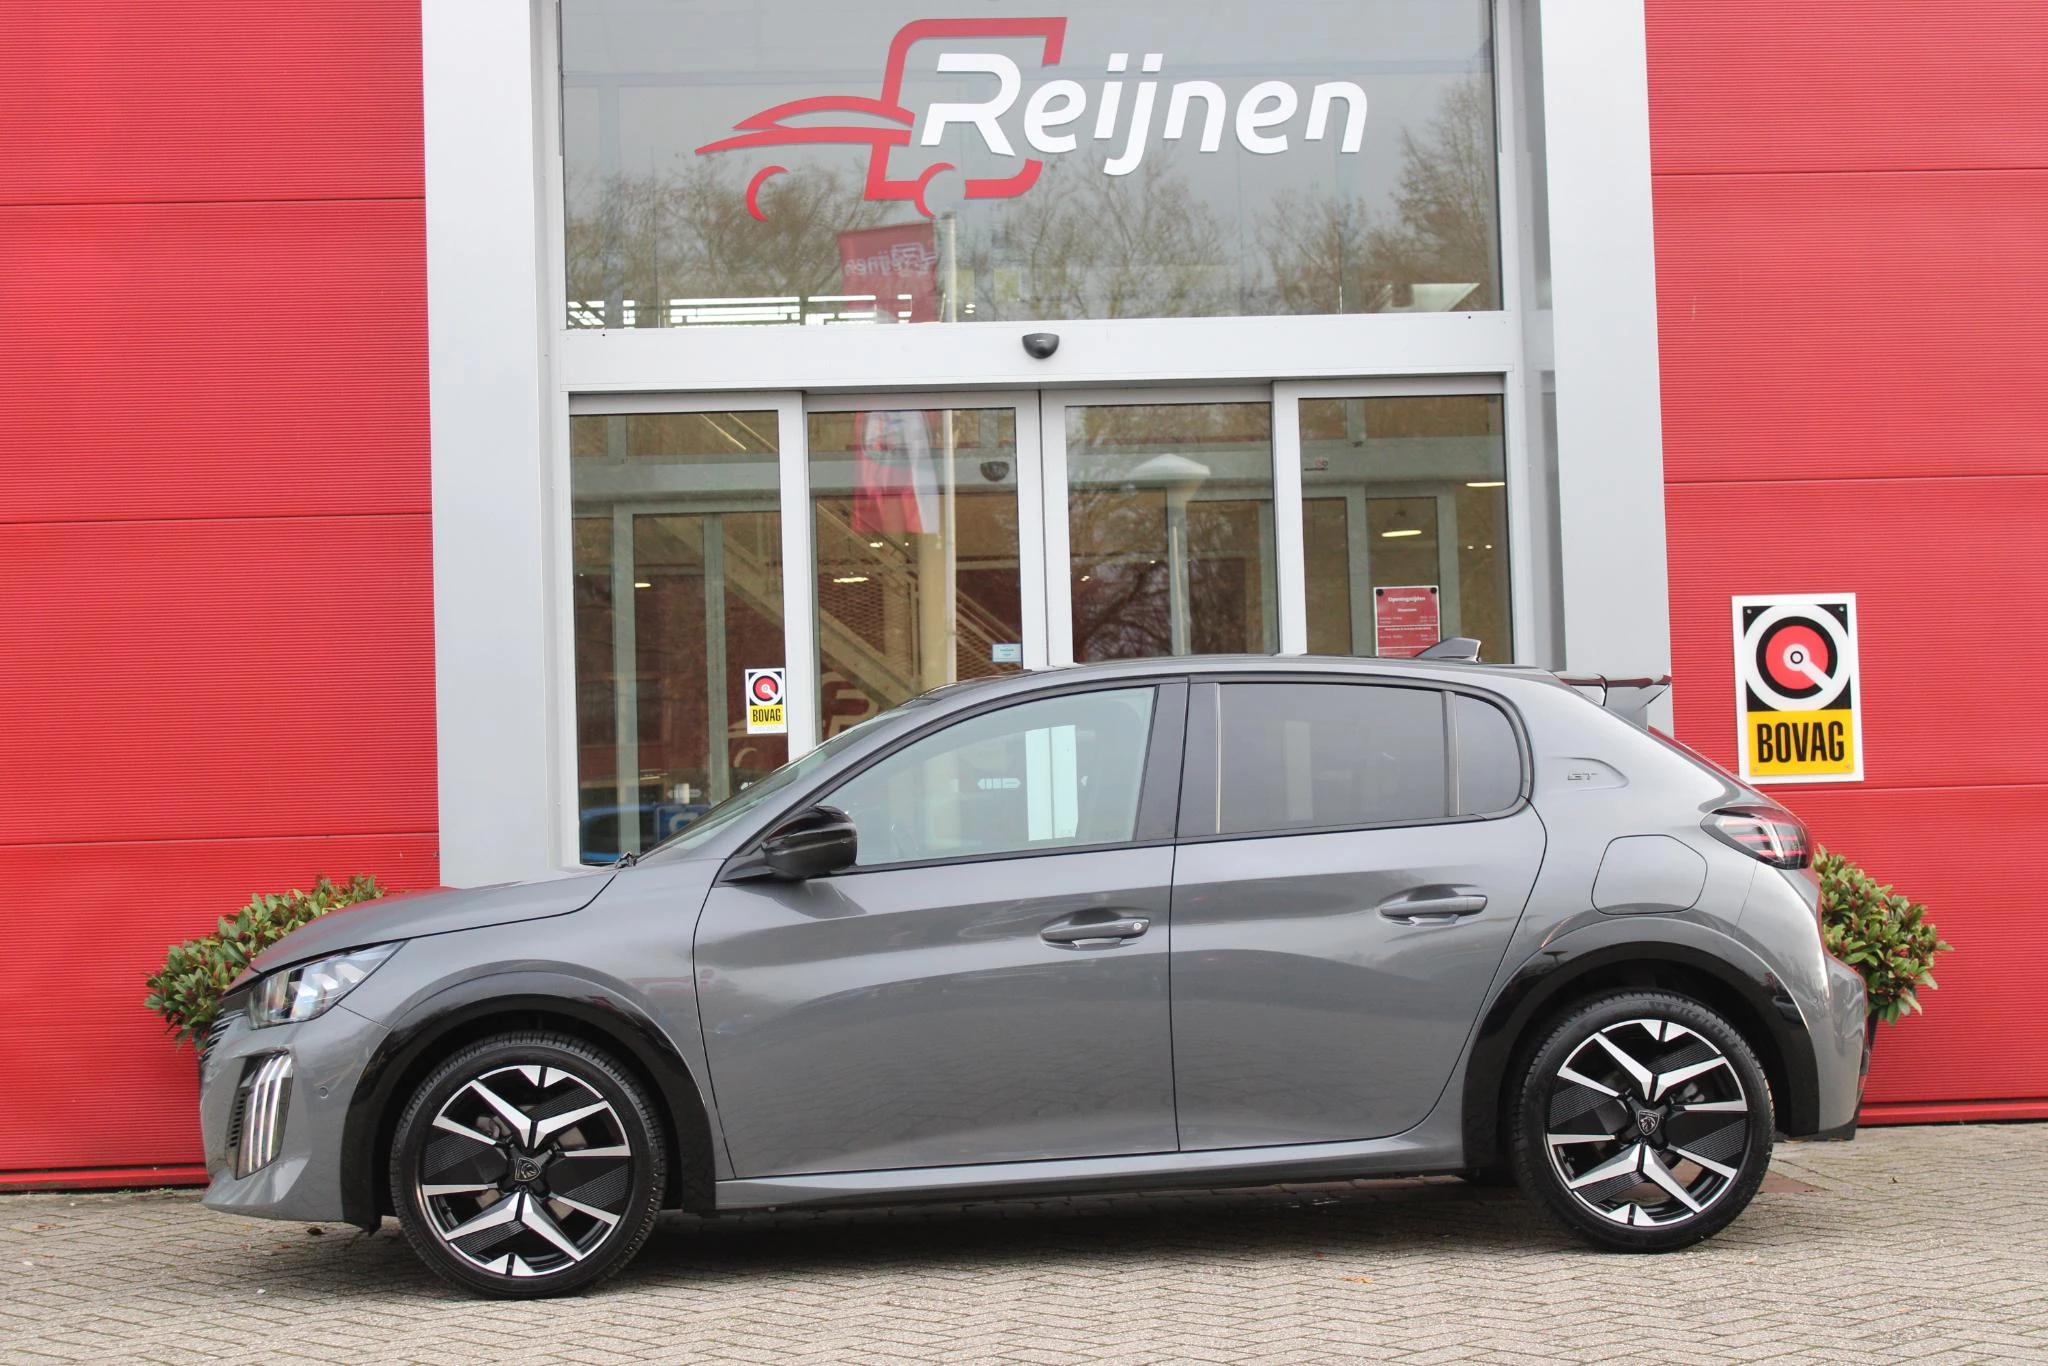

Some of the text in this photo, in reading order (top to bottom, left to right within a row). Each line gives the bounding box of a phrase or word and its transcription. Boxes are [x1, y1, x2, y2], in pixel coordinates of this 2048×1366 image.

[920, 53, 1368, 176] Reijnen
[752, 708, 781, 722] BOVAG
[1757, 721, 1845, 763] BOVAG
